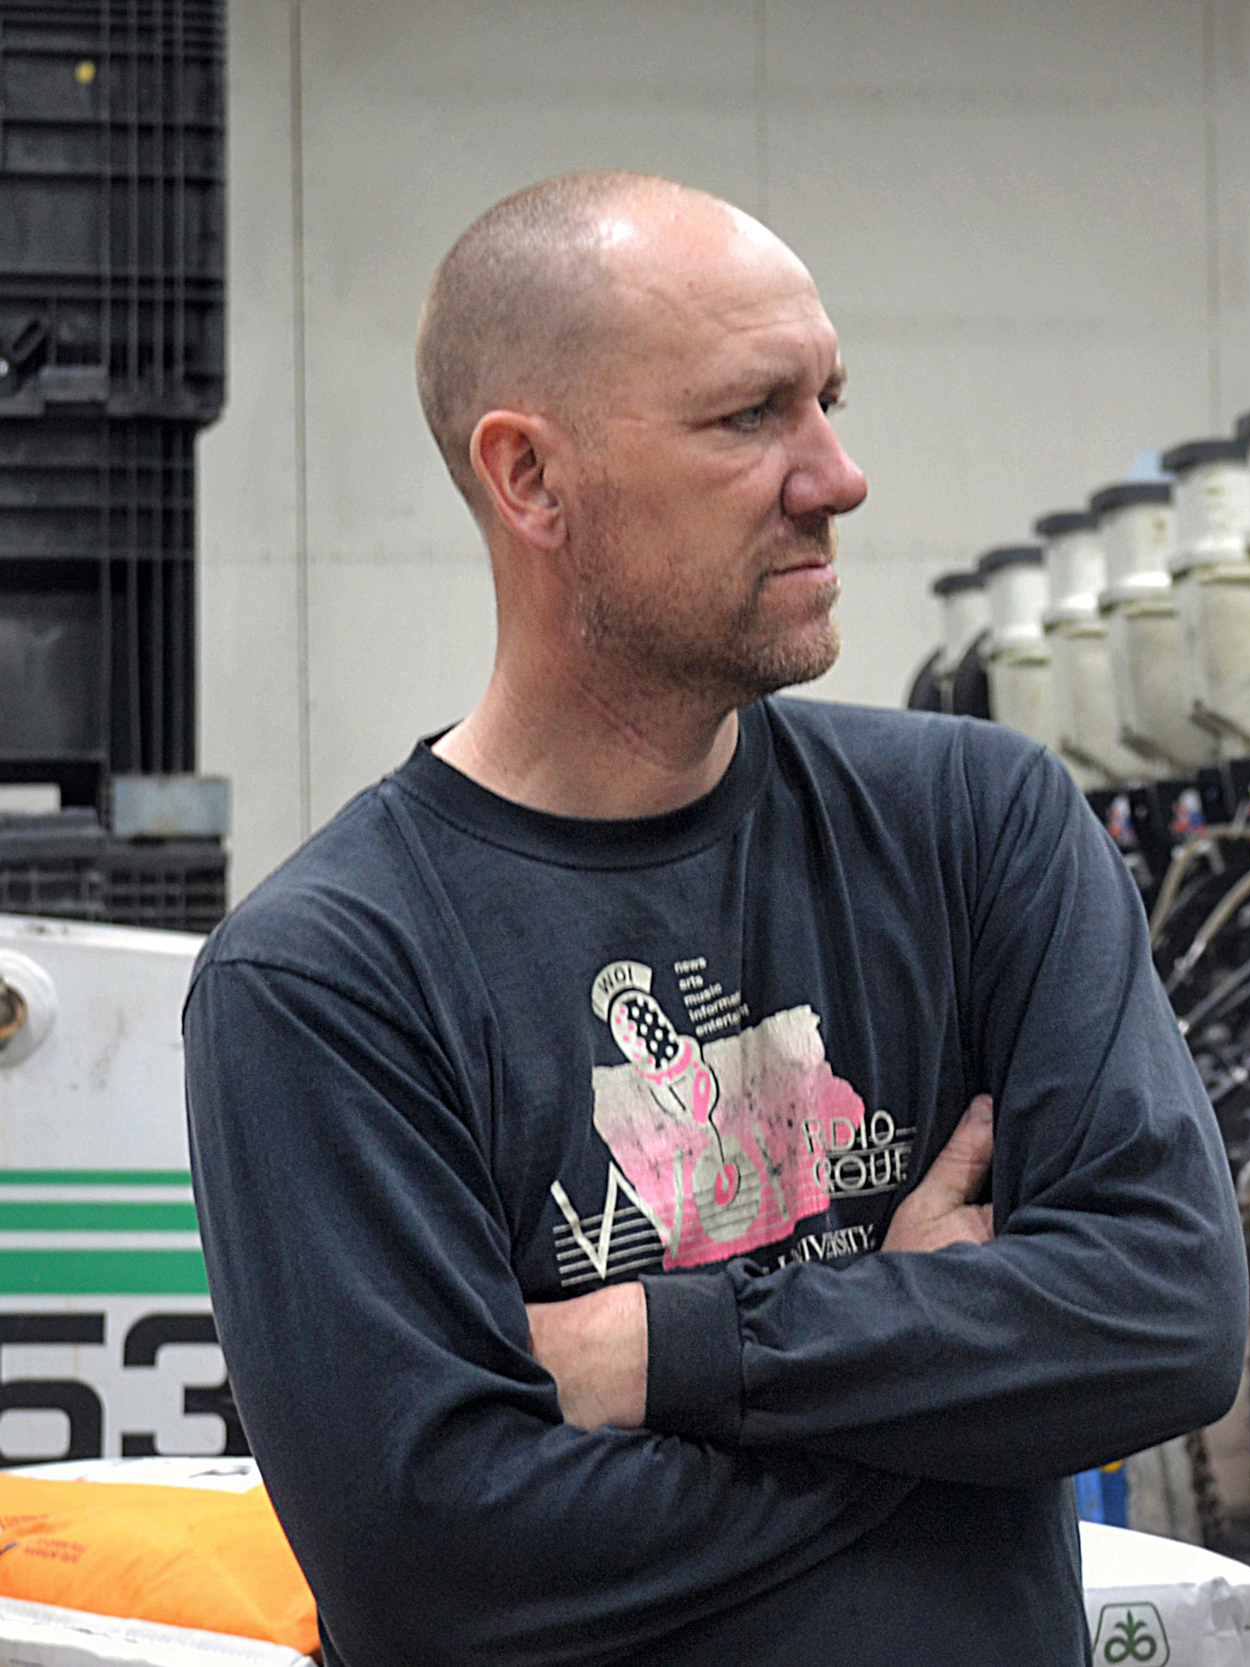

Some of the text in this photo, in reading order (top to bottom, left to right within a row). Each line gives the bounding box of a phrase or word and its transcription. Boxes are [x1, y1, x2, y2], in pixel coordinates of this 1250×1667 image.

[674, 956, 707, 975] news
[598, 965, 633, 994] WOI
[679, 975, 704, 992] arts
[683, 982, 722, 1008] music
